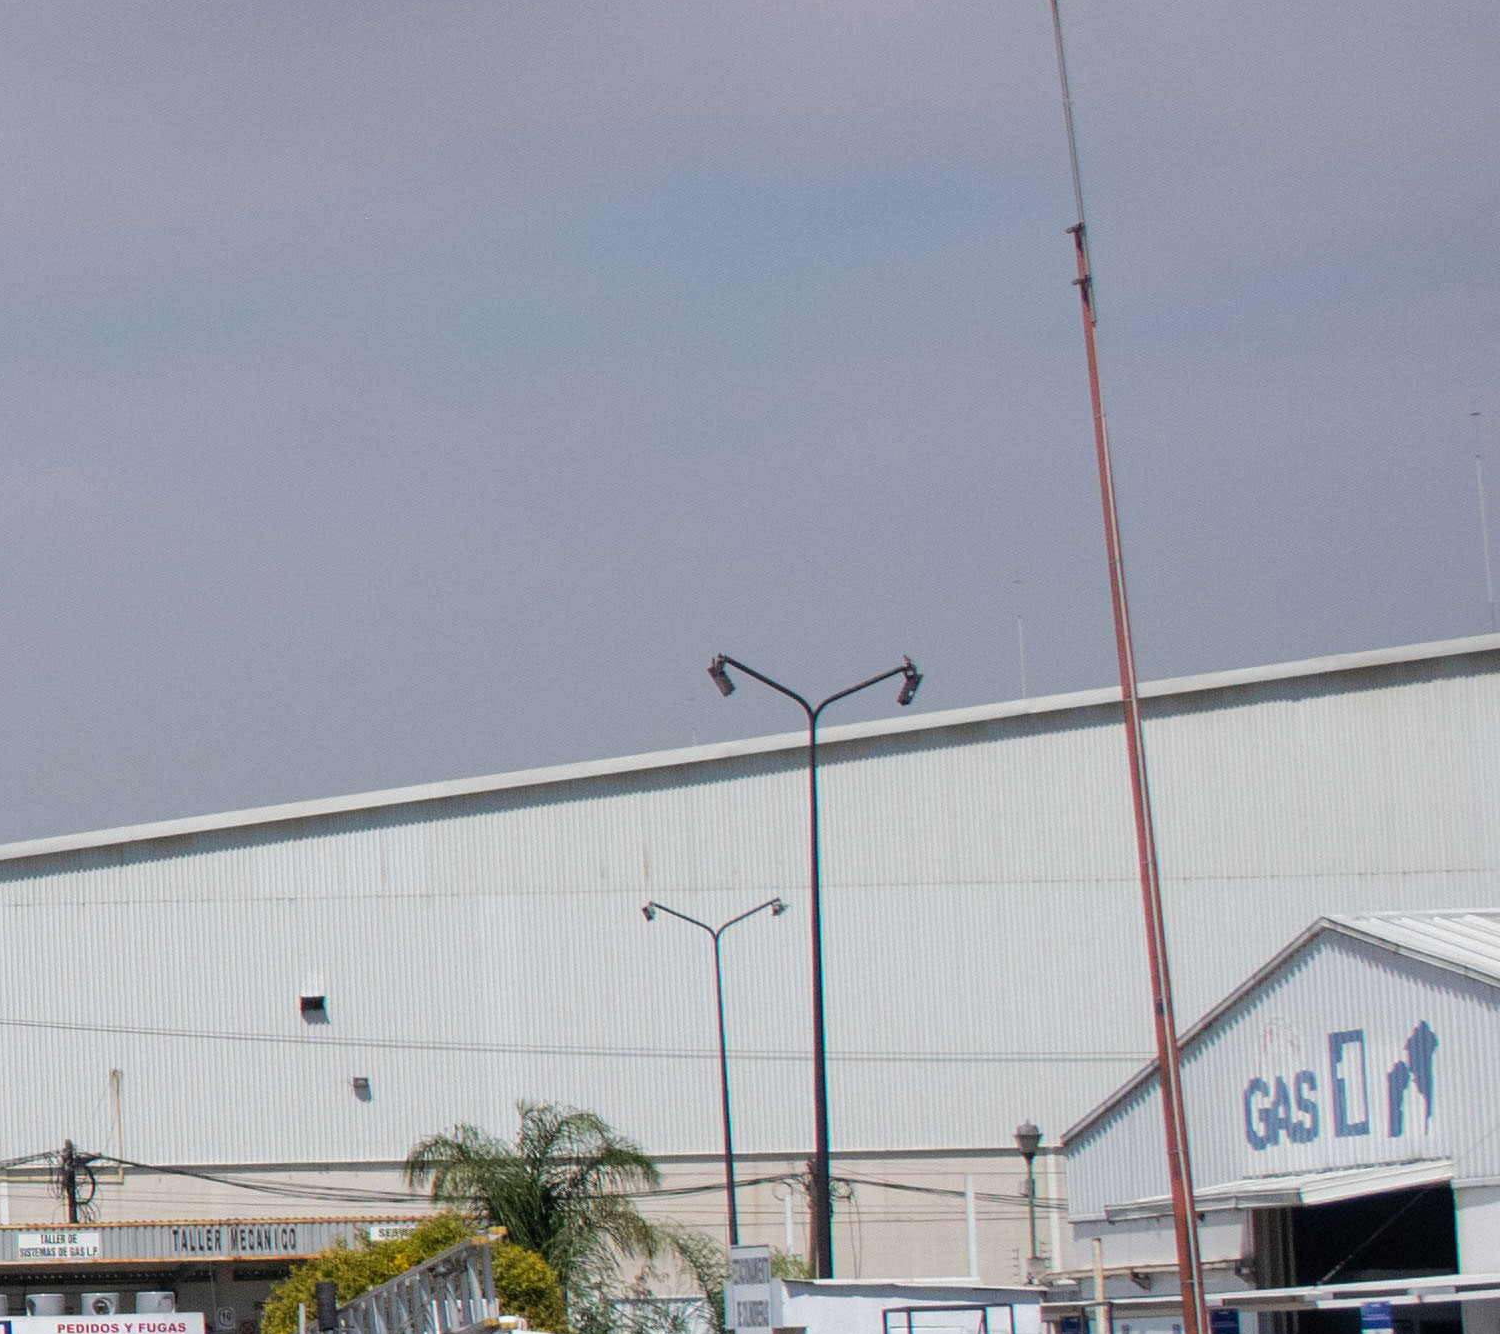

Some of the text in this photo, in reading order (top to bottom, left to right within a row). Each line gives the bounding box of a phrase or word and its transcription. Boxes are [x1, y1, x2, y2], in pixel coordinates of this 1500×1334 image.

[1244, 1037, 1367, 1151] GAS 1
[41, 1234, 77, 1245] TALLER DE
[172, 1227, 296, 1252] TALLER MECANICO
[20, 1248, 56, 1258] SISTEMAS
[58, 1248, 67, 1258] DE
[70, 1247, 85, 1257] GAS
[57, 1322, 186, 1334] PEDIDOS Y FUGAS
